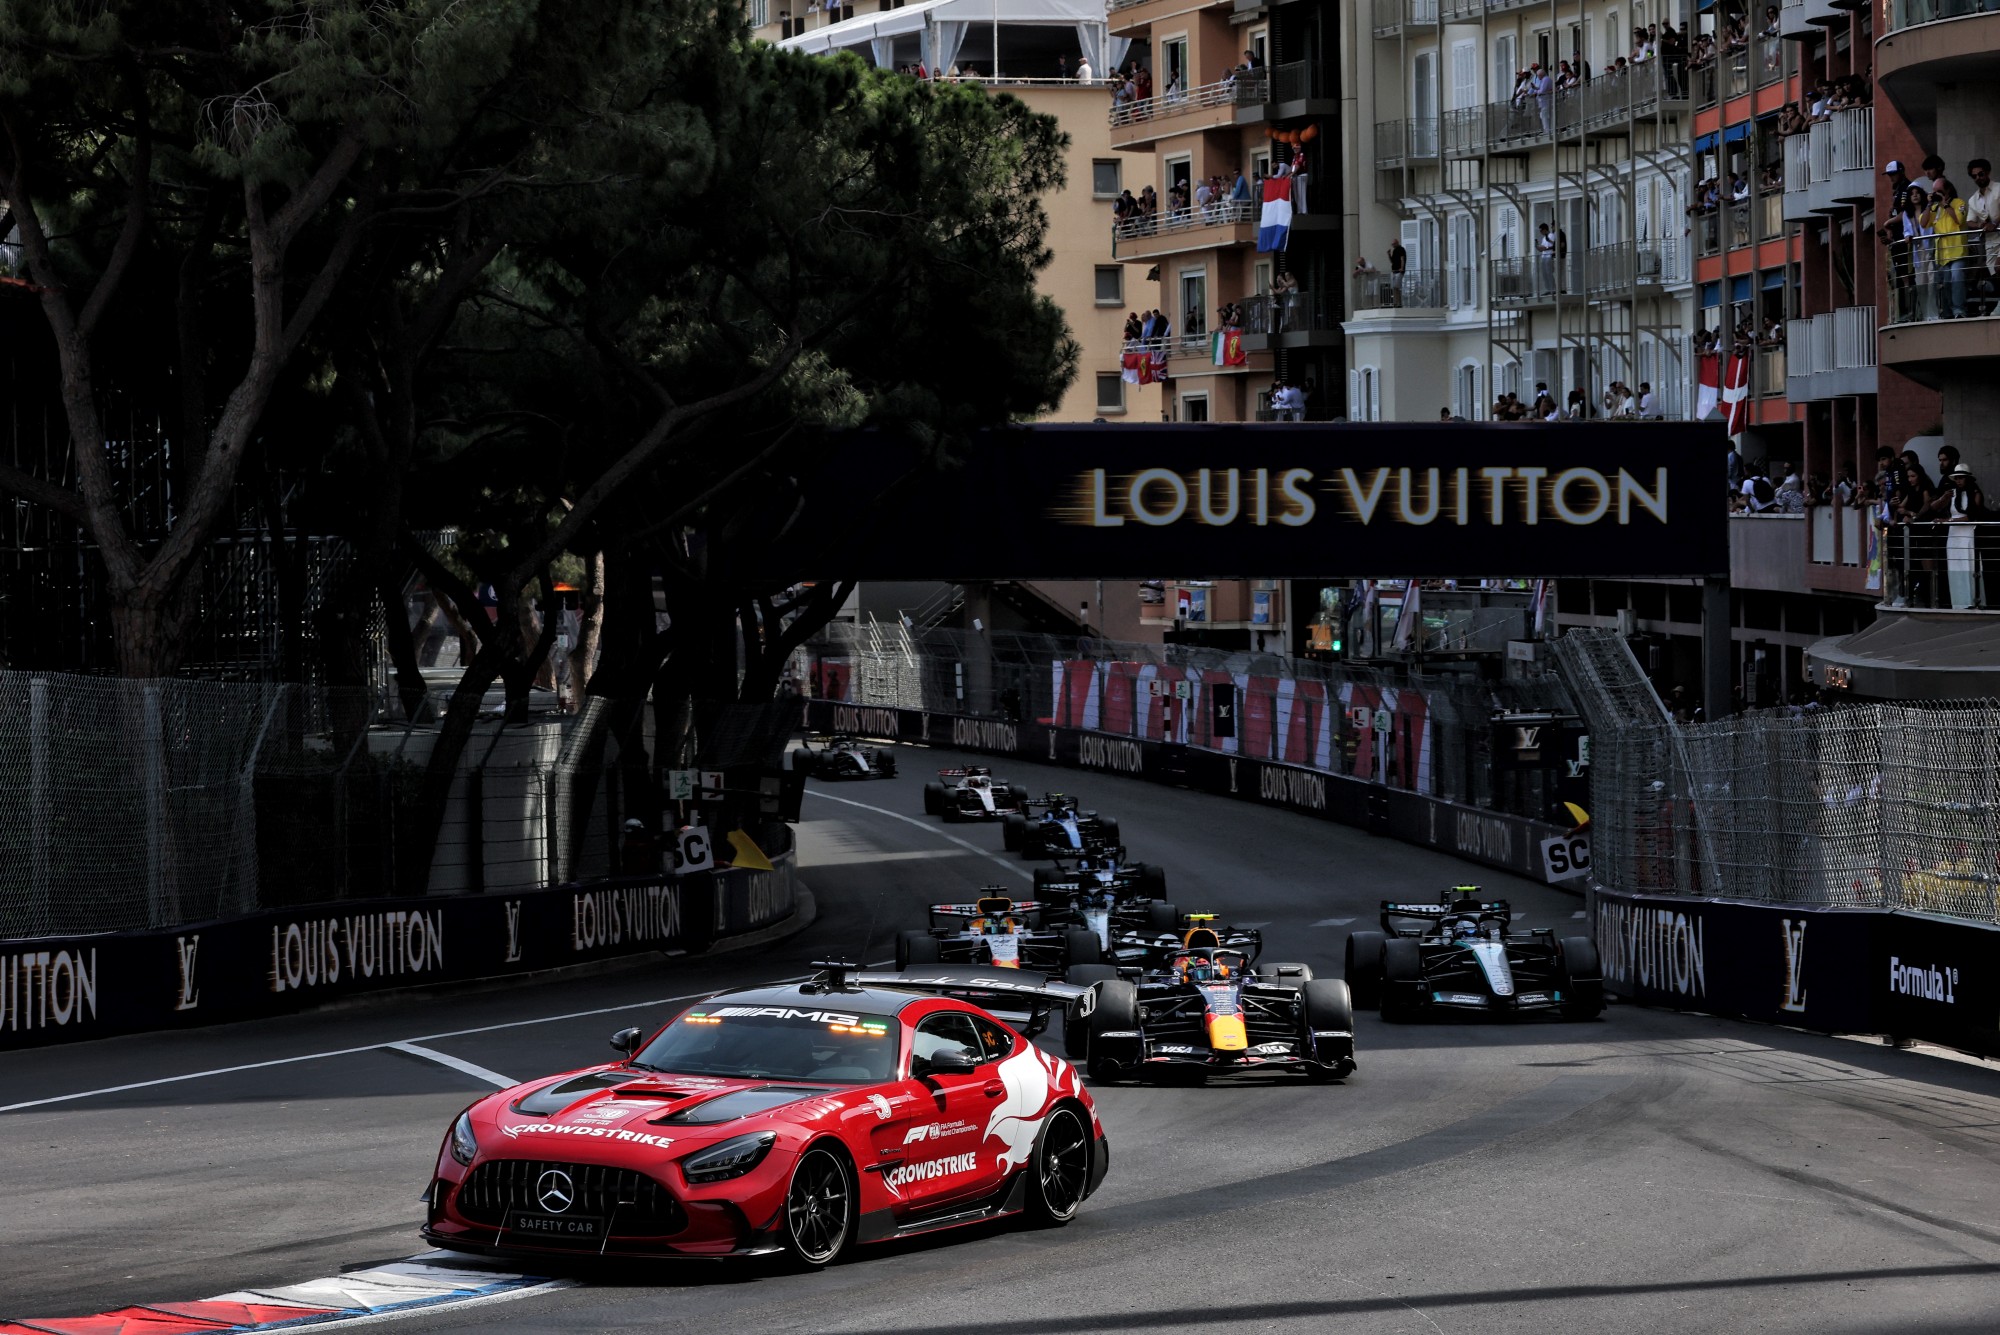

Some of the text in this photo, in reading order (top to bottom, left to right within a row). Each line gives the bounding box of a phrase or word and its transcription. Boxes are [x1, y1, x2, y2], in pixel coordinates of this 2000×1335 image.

[1091, 466, 1668, 527] LOUIS VUITTON
[833, 704, 859, 733] LOUIS
[860, 708, 899, 736] VUITTON
[953, 717, 980, 748] LOUIS
[981, 720, 1017, 752] VUITTON
[1079, 735, 1105, 768] LOUIS
[1106, 739, 1143, 773] VUITTON
[1260, 765, 1287, 802] LOUIS
[1288, 770, 1326, 810] VUITTON
[1456, 810, 1480, 856] LOUIS
[1481, 816, 1512, 864] VUITTON
[1548, 838, 1590, 874] SC
[573, 889, 620, 951] LOUIS
[623, 884, 681, 942] VUITTON
[272, 909, 443, 993] LOUIS VUITTON
[1627, 905, 1706, 999] VUITTON
[1890, 956, 1944, 1002] Formula
[751, 1007, 860, 1026] AMG
[1160, 1045, 1193, 1054] VISA
[1258, 1045, 1291, 1054] VISA
[511, 1122, 675, 1149] CROWDSTRIKE
[902, 1125, 930, 1145] F1
[889, 1151, 977, 1186] CROWDSTRIKE
[520, 1217, 593, 1233] SAFETY CAR
